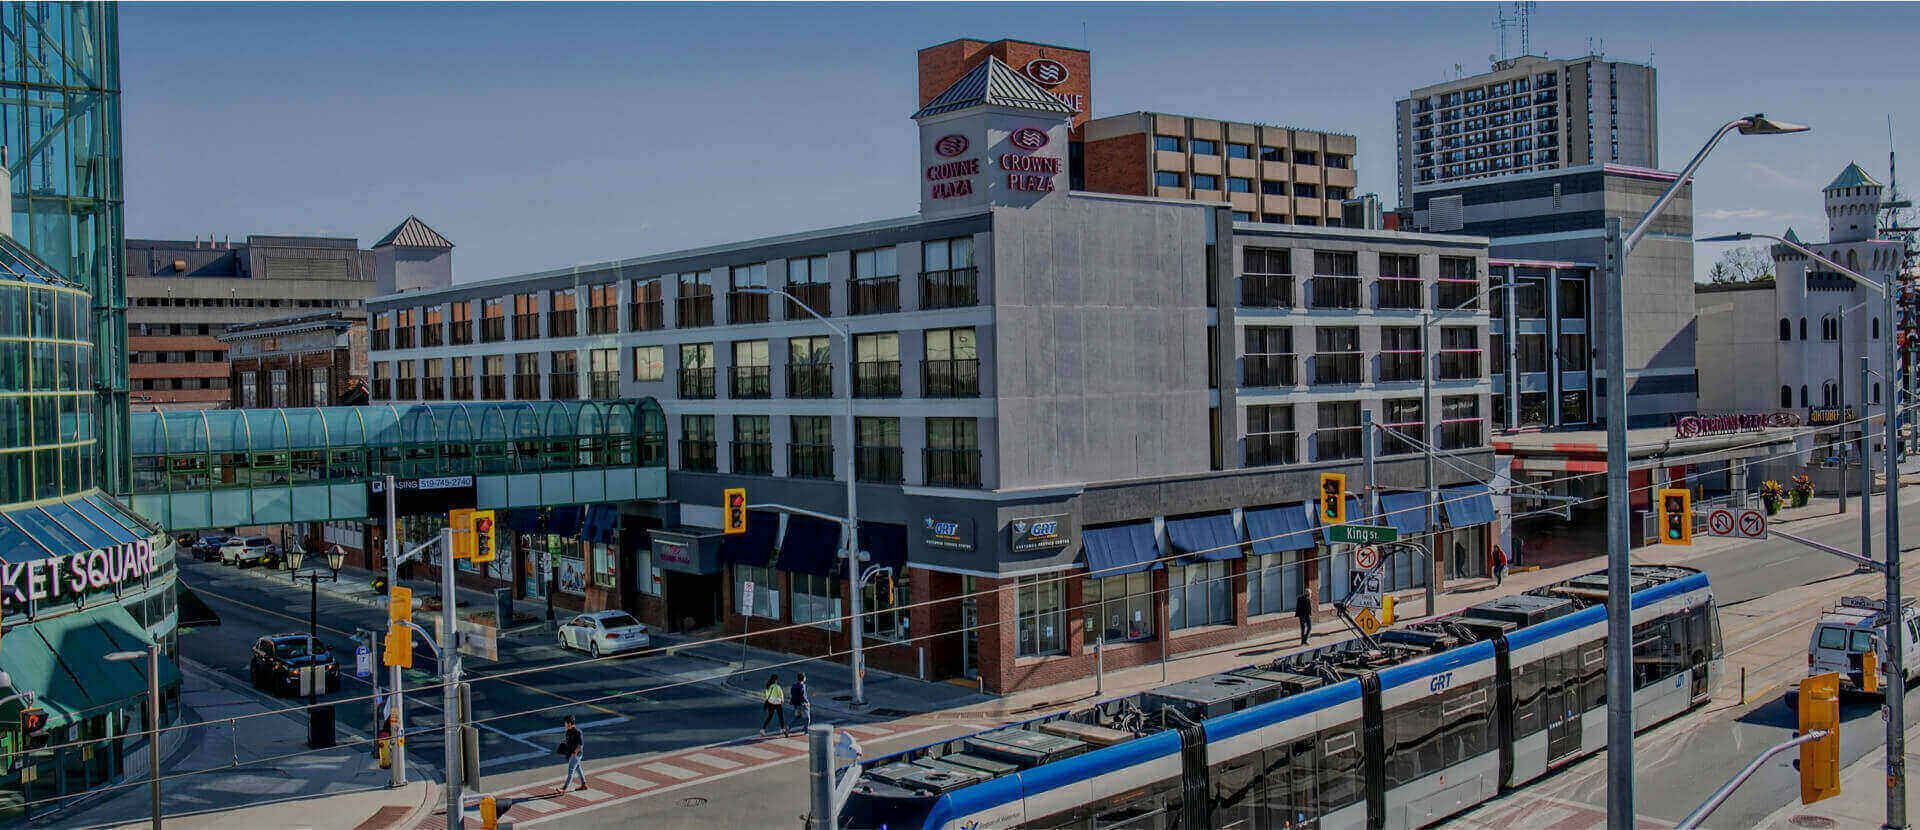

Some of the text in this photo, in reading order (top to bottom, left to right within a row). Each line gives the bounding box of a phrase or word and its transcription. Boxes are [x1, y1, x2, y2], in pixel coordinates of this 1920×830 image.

[927, 159, 979, 181] CROWNE
[1001, 153, 1063, 174] CROWNE
[932, 179, 973, 199] PLAZA
[1008, 174, 1055, 192] PLAZA
[935, 522, 958, 536] GRT
[1031, 521, 1056, 536] GRT
[1346, 527, 1368, 542] King
[1, 537, 158, 602] KET SQUARE
[1361, 618, 1374, 631] 10
[1431, 672, 1453, 692] GRT
